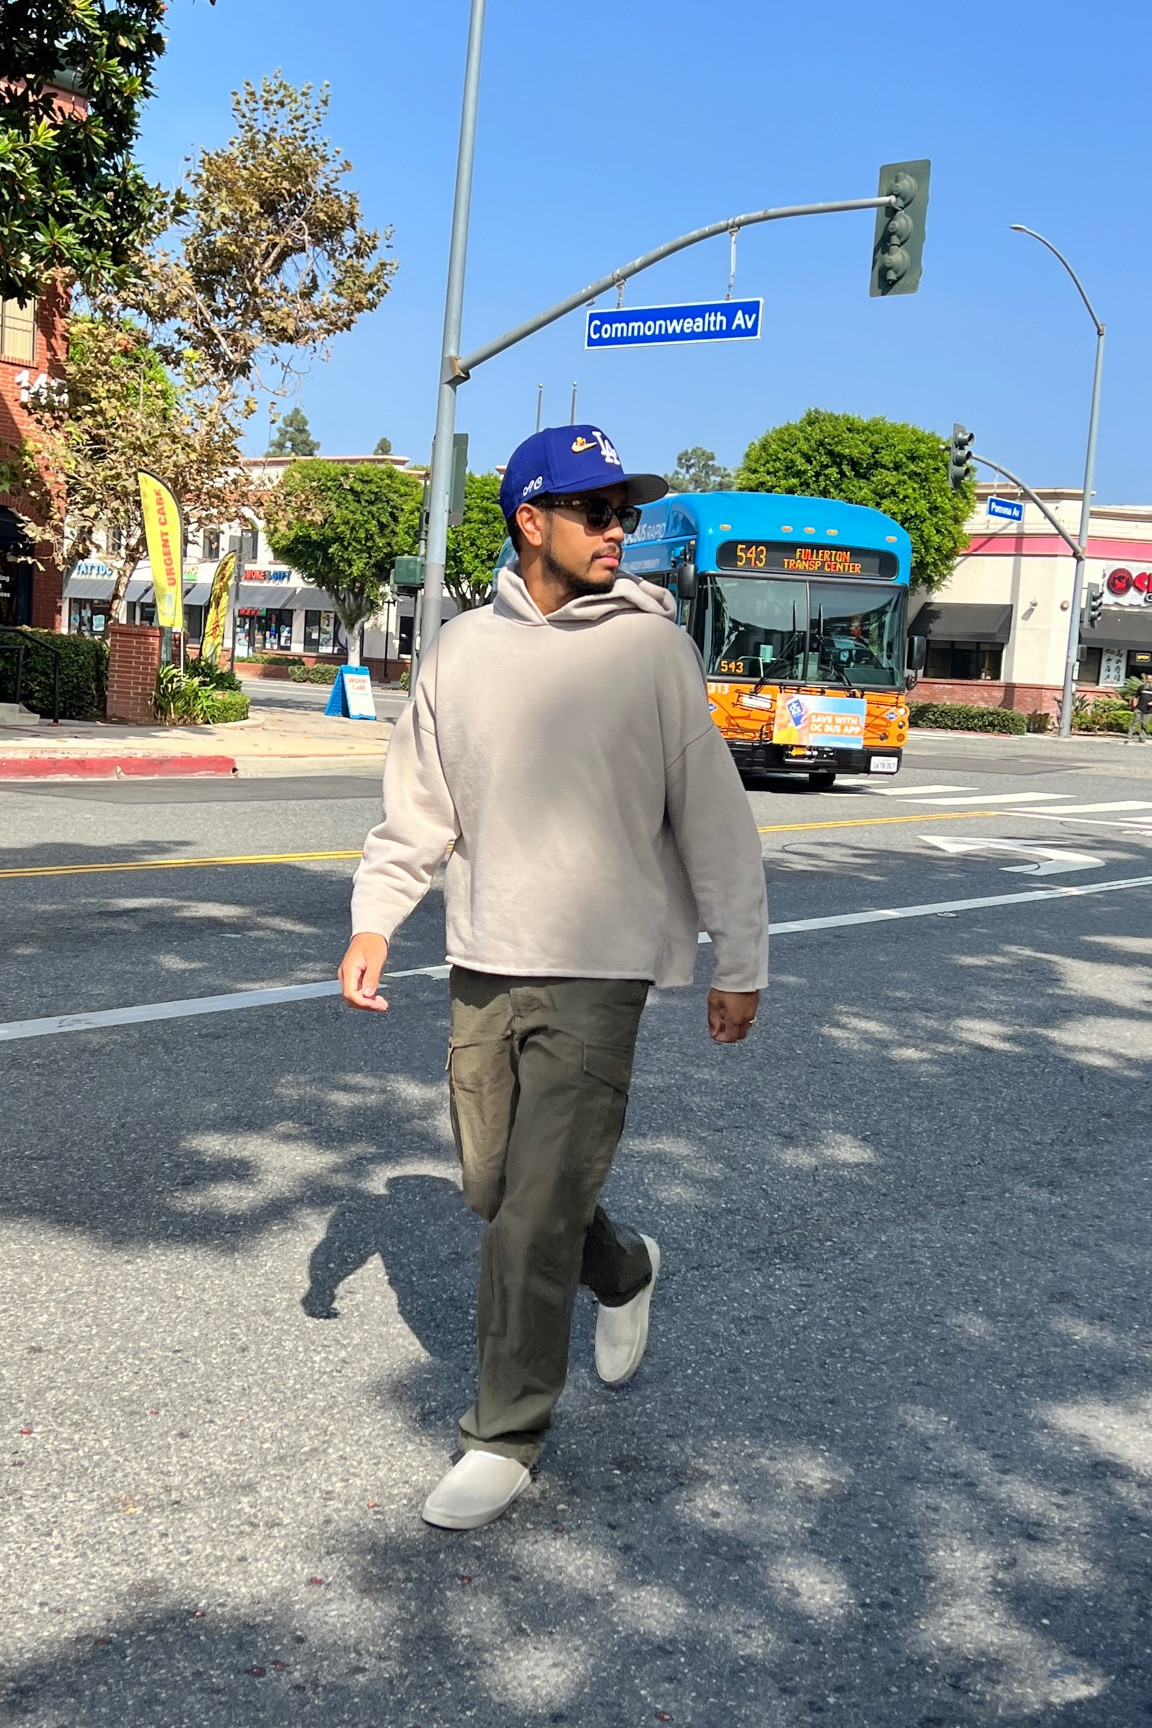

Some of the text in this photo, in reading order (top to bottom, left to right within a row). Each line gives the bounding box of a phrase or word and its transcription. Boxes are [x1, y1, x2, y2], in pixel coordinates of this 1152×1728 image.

[590, 309, 757, 339] Commonwealth Av
[592, 431, 620, 465] LA
[991, 501, 1012, 515] Pomona
[153, 488, 176, 587] URGENT CARE
[736, 544, 767, 568] 543
[795, 548, 850, 563] FULLERTON
[783, 558, 862, 574] TRANSP CENTER
[720, 660, 744, 673] 543
[811, 714, 859, 726] SAVE WITH
[810, 723, 861, 735] OC BUS APP
